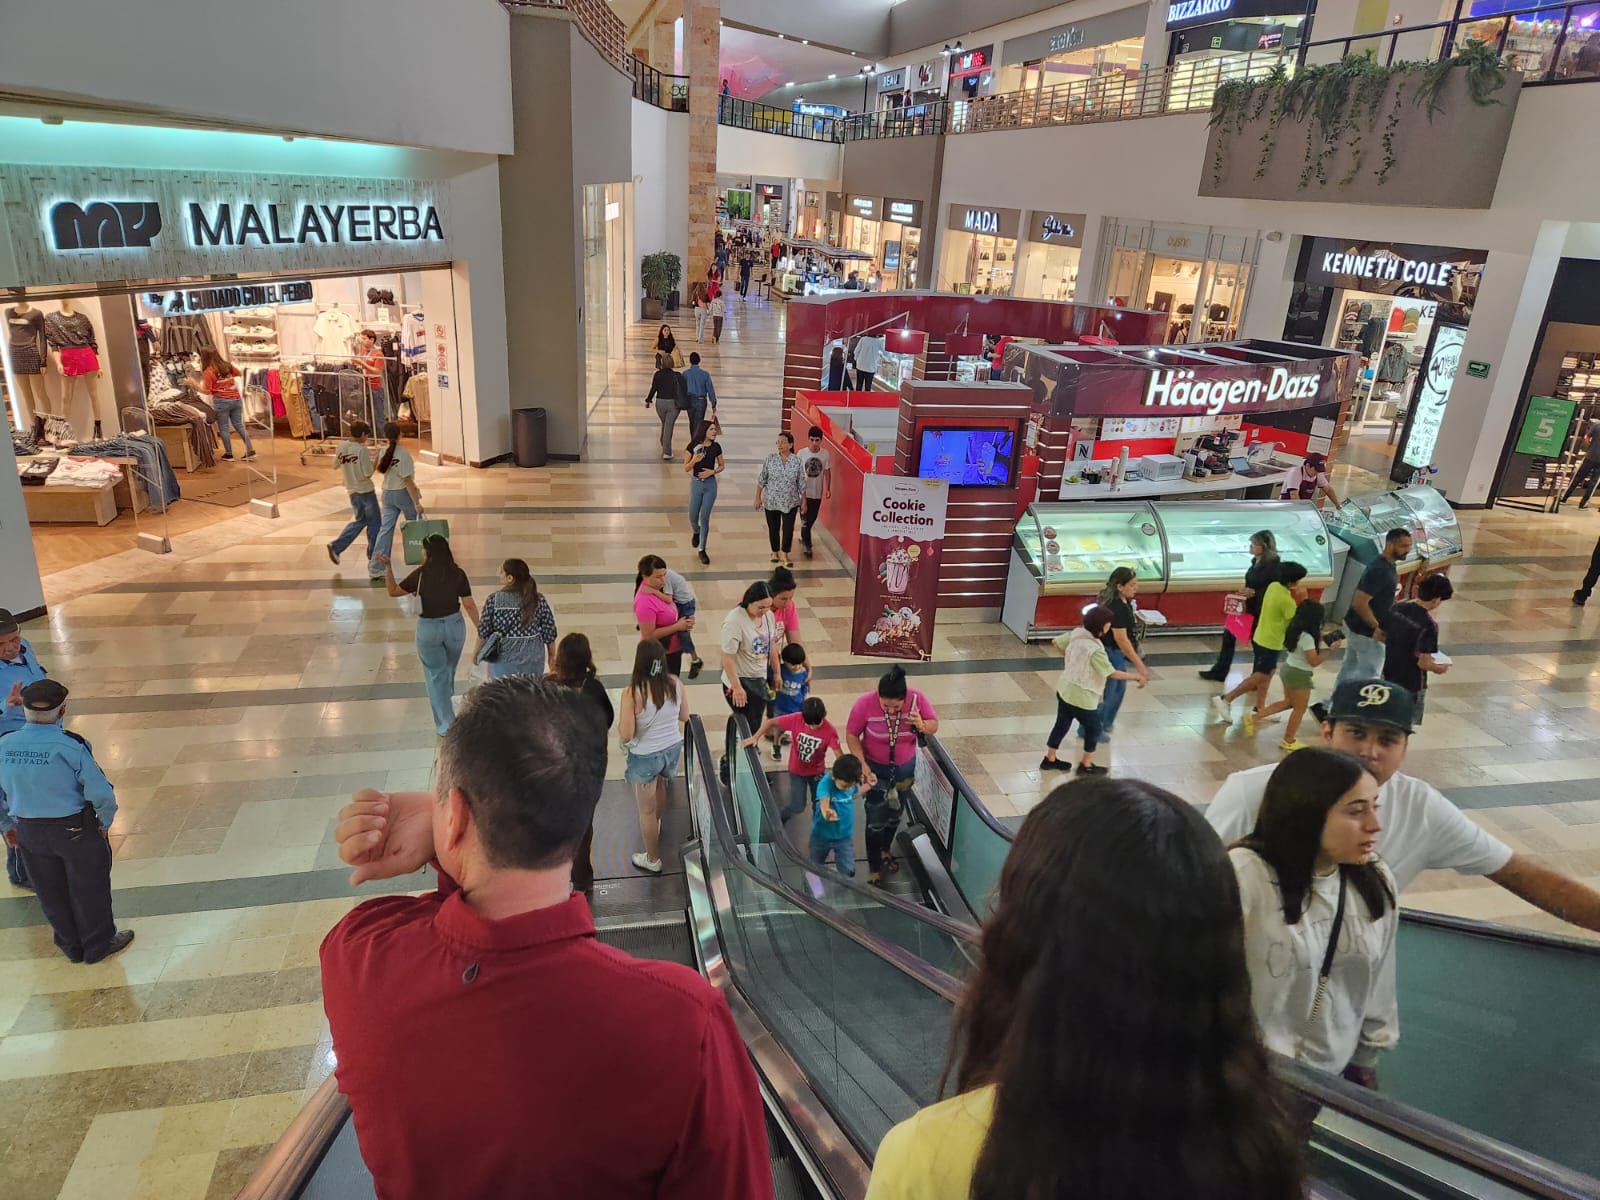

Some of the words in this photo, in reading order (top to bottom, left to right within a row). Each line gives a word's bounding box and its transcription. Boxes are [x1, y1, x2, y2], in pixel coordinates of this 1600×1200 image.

[188, 203, 444, 246] MALAYERBA
[965, 209, 999, 233] MADA
[1322, 252, 1399, 280] KENNETH
[1402, 260, 1452, 287] COLE
[187, 287, 241, 311] CUIDADO
[241, 286, 266, 306] CON
[267, 285, 281, 304] EL
[281, 281, 314, 302] PERRO
[1145, 367, 1321, 415] Häagen-Dazs
[1535, 417, 1556, 438] 5
[883, 497, 926, 512] Cookie
[873, 510, 934, 526] Collection
[798, 734, 820, 749] JUST
[798, 744, 813, 754] DO
